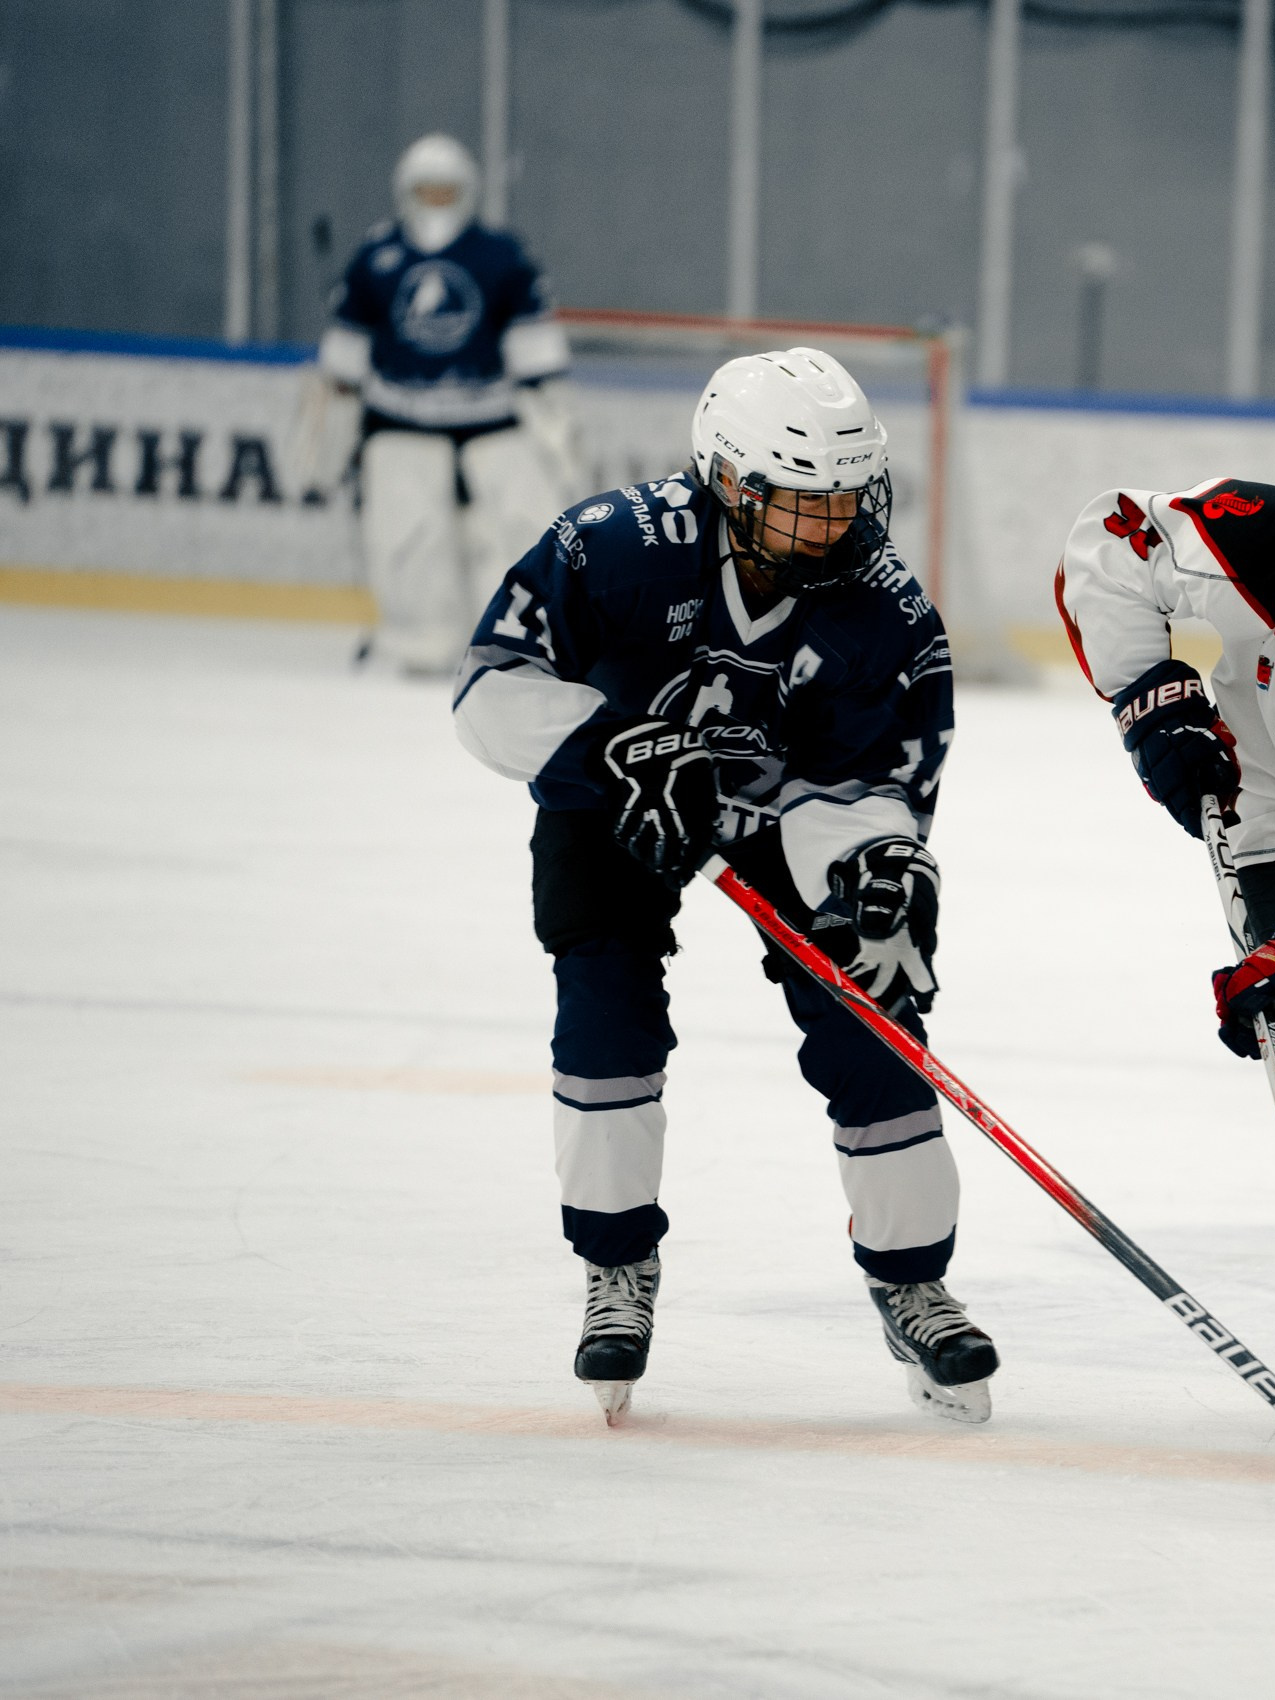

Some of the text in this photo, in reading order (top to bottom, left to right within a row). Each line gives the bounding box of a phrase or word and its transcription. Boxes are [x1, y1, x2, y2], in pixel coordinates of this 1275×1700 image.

[715, 432, 746, 459] CCM
[836, 452, 873, 466] CCM
[1116, 678, 1205, 737] AUER
